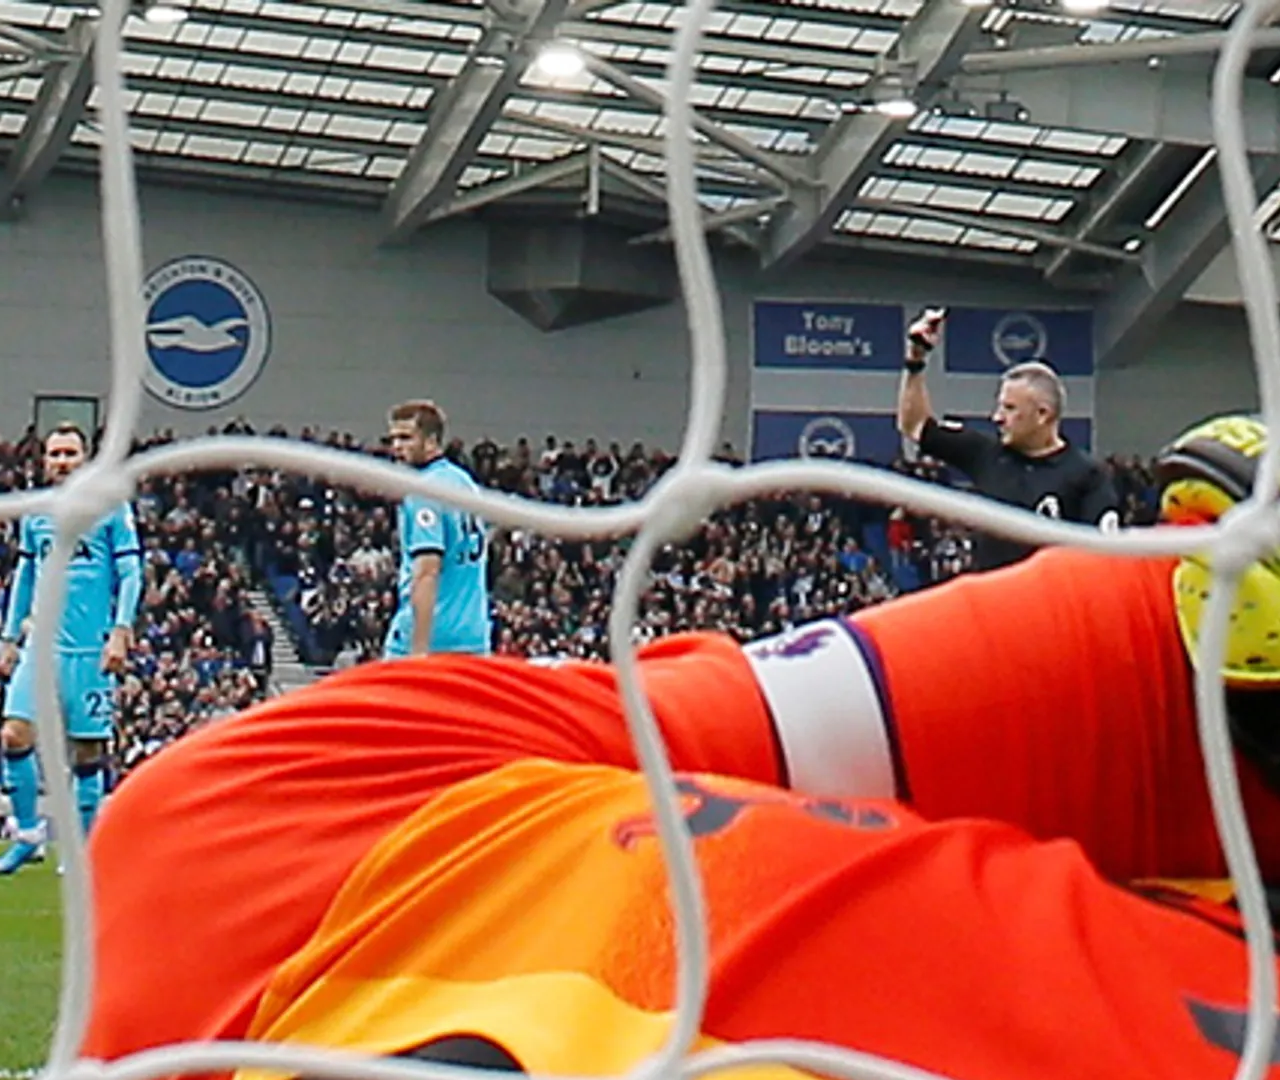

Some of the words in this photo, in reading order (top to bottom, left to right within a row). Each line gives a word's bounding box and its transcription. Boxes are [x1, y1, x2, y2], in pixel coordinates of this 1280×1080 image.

[802, 311, 854, 335] Tony
[785, 335, 872, 355] Bloom's
[40, 537, 94, 562] AA
